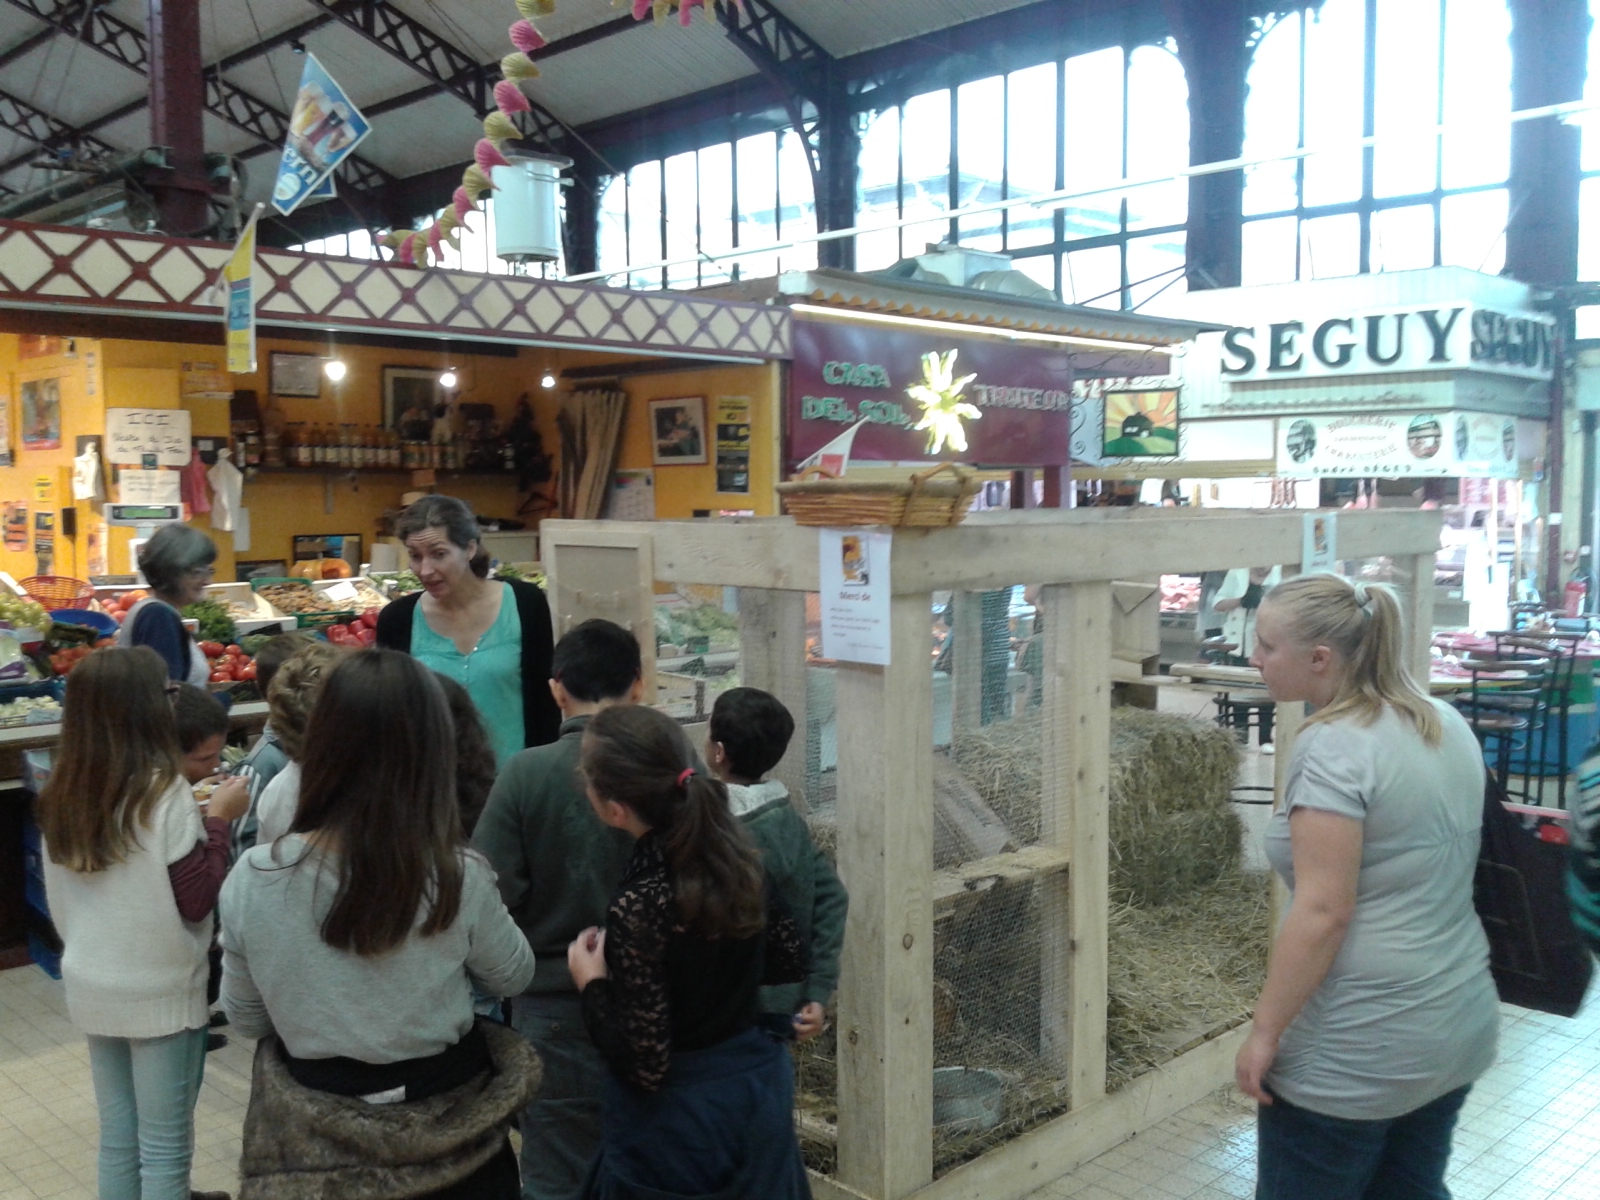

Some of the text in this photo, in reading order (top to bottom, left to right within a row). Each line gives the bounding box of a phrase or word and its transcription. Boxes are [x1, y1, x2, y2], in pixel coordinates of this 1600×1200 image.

[1220, 307, 1466, 376] SEGUY
[822, 360, 892, 389] CASA
[125, 411, 171, 426] ICI
[801, 395, 911, 425] DEL SOL
